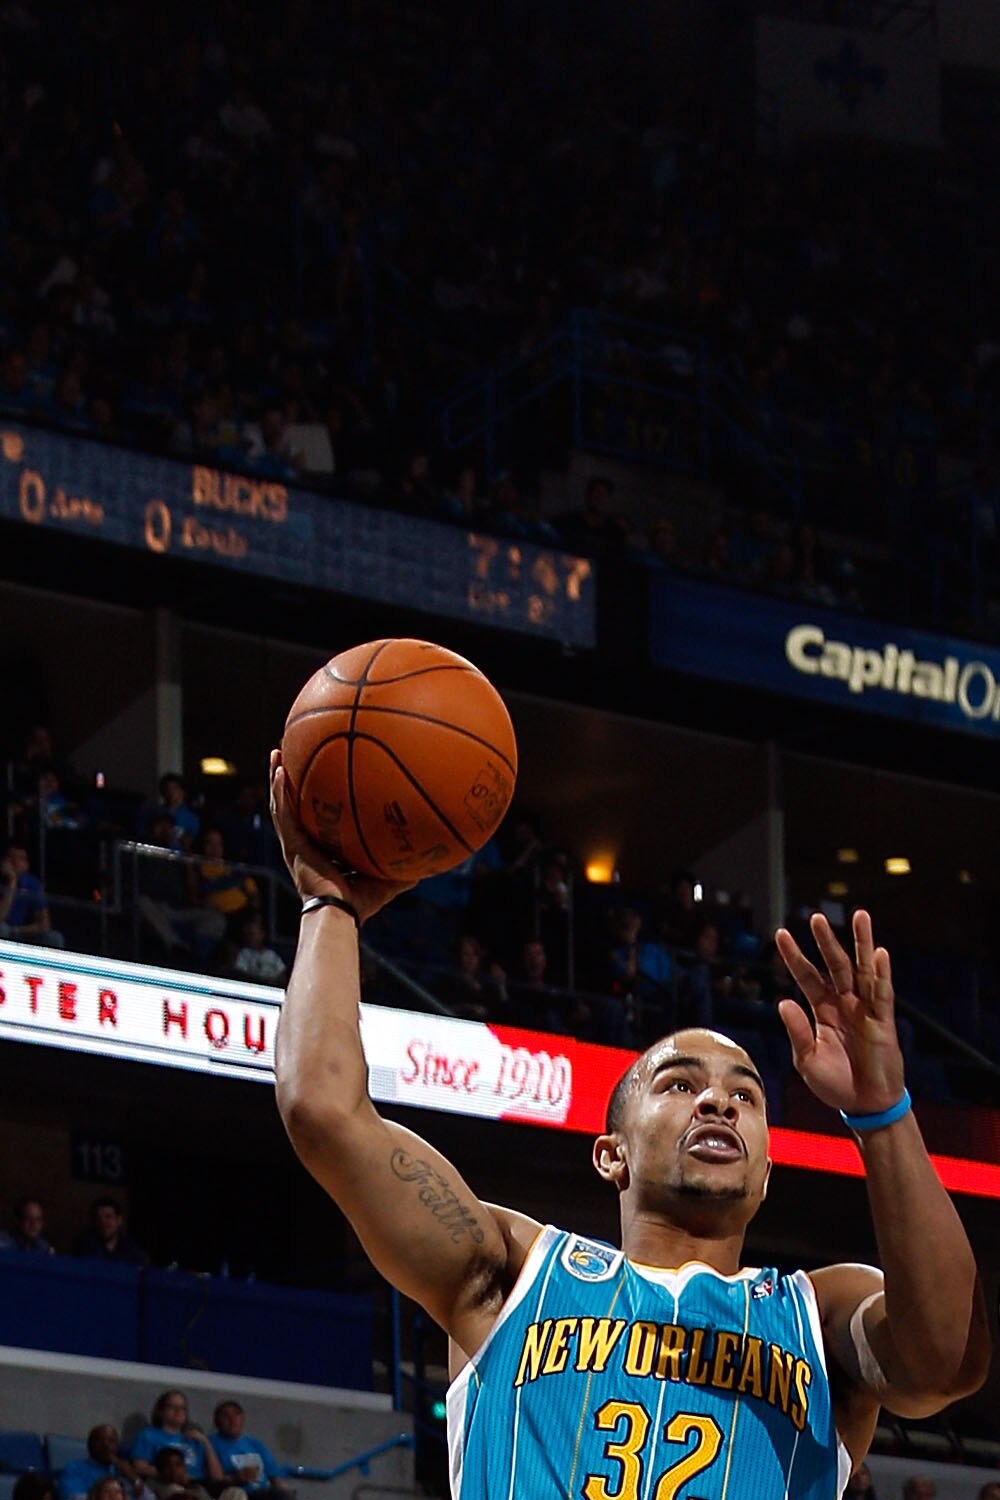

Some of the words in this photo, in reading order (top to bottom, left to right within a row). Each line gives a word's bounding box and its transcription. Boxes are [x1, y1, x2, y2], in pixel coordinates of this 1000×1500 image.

[192, 463, 289, 523] BUCKS
[145, 500, 172, 555] 0
[78, 1141, 122, 1180] 113
[513, 1316, 626, 1388] NEW
[621, 1320, 812, 1432] ORLEANS
